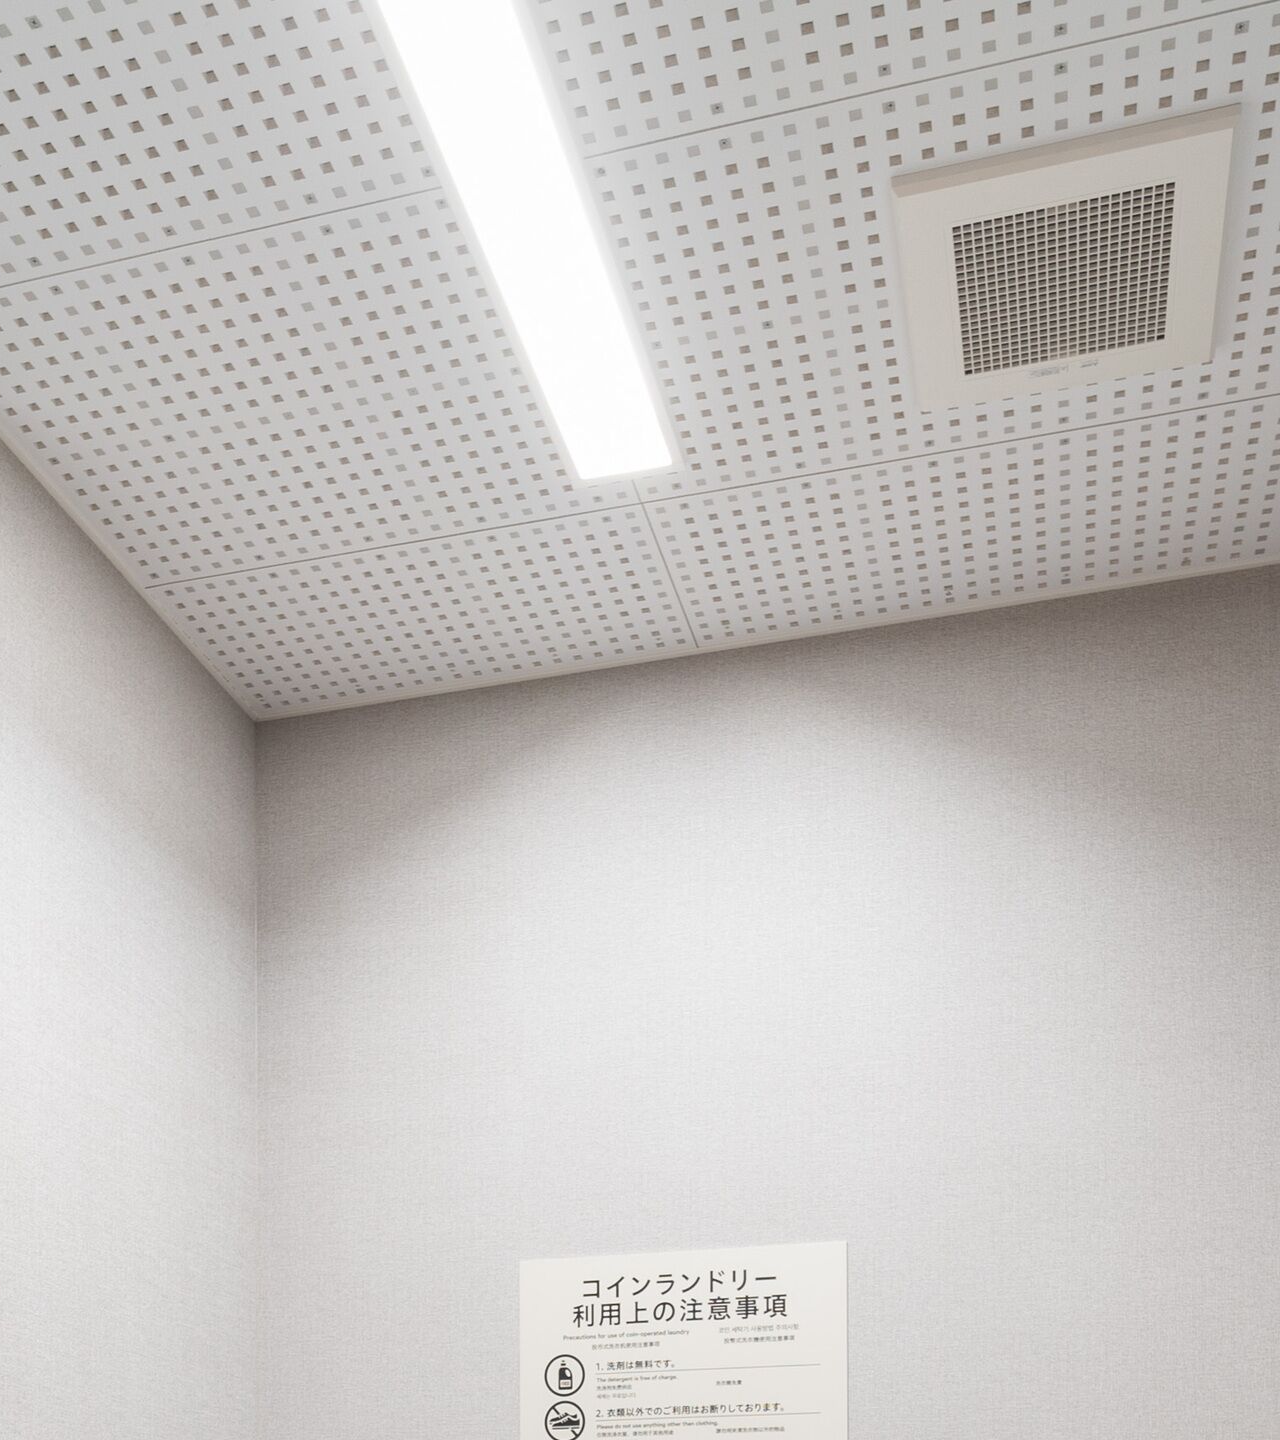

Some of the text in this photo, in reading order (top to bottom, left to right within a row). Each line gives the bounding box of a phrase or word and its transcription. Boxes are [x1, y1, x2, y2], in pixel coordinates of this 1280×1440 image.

[582, 1269, 777, 1298] コインランドリー
[573, 1294, 788, 1328] 利用上の注意事項
[596, 1359, 675, 1371] 1. 洗剤は無料です。
[596, 1403, 784, 1418] 2. 衣類以外でのご利用はお断りしております。
